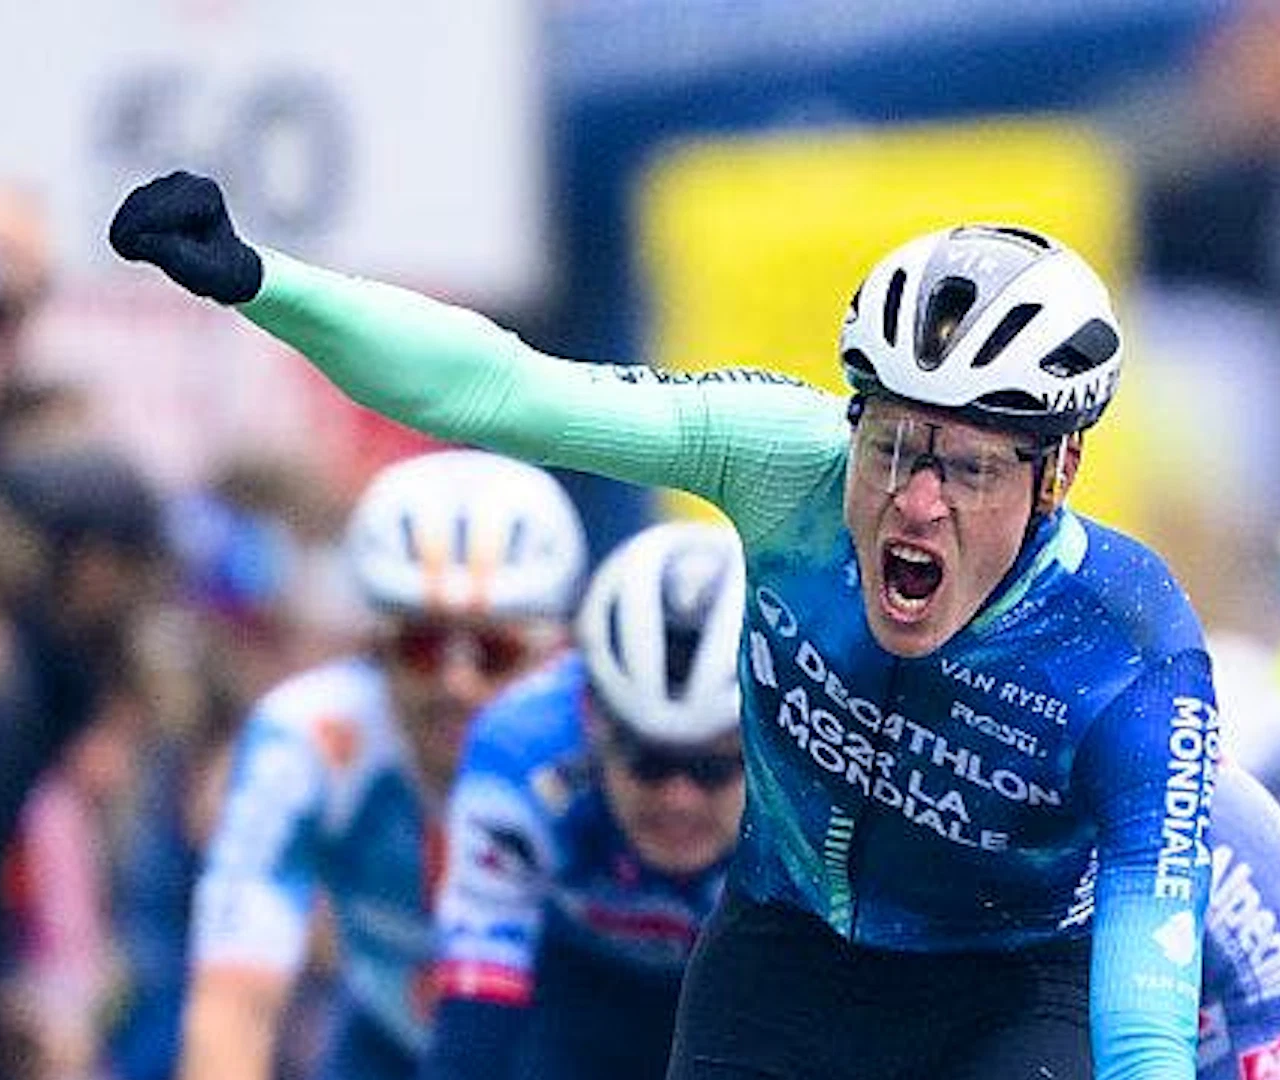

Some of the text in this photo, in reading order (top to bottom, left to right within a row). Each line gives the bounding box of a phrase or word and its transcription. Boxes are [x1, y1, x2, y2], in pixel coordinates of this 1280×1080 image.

[785, 687, 972, 824] AG2R LA
[795, 640, 1061, 806] DECATHLON
[940, 658, 1068, 725] VAN RYSEL
[777, 702, 1009, 850] MONDIALE
[1155, 696, 1203, 900] MONDIALE
